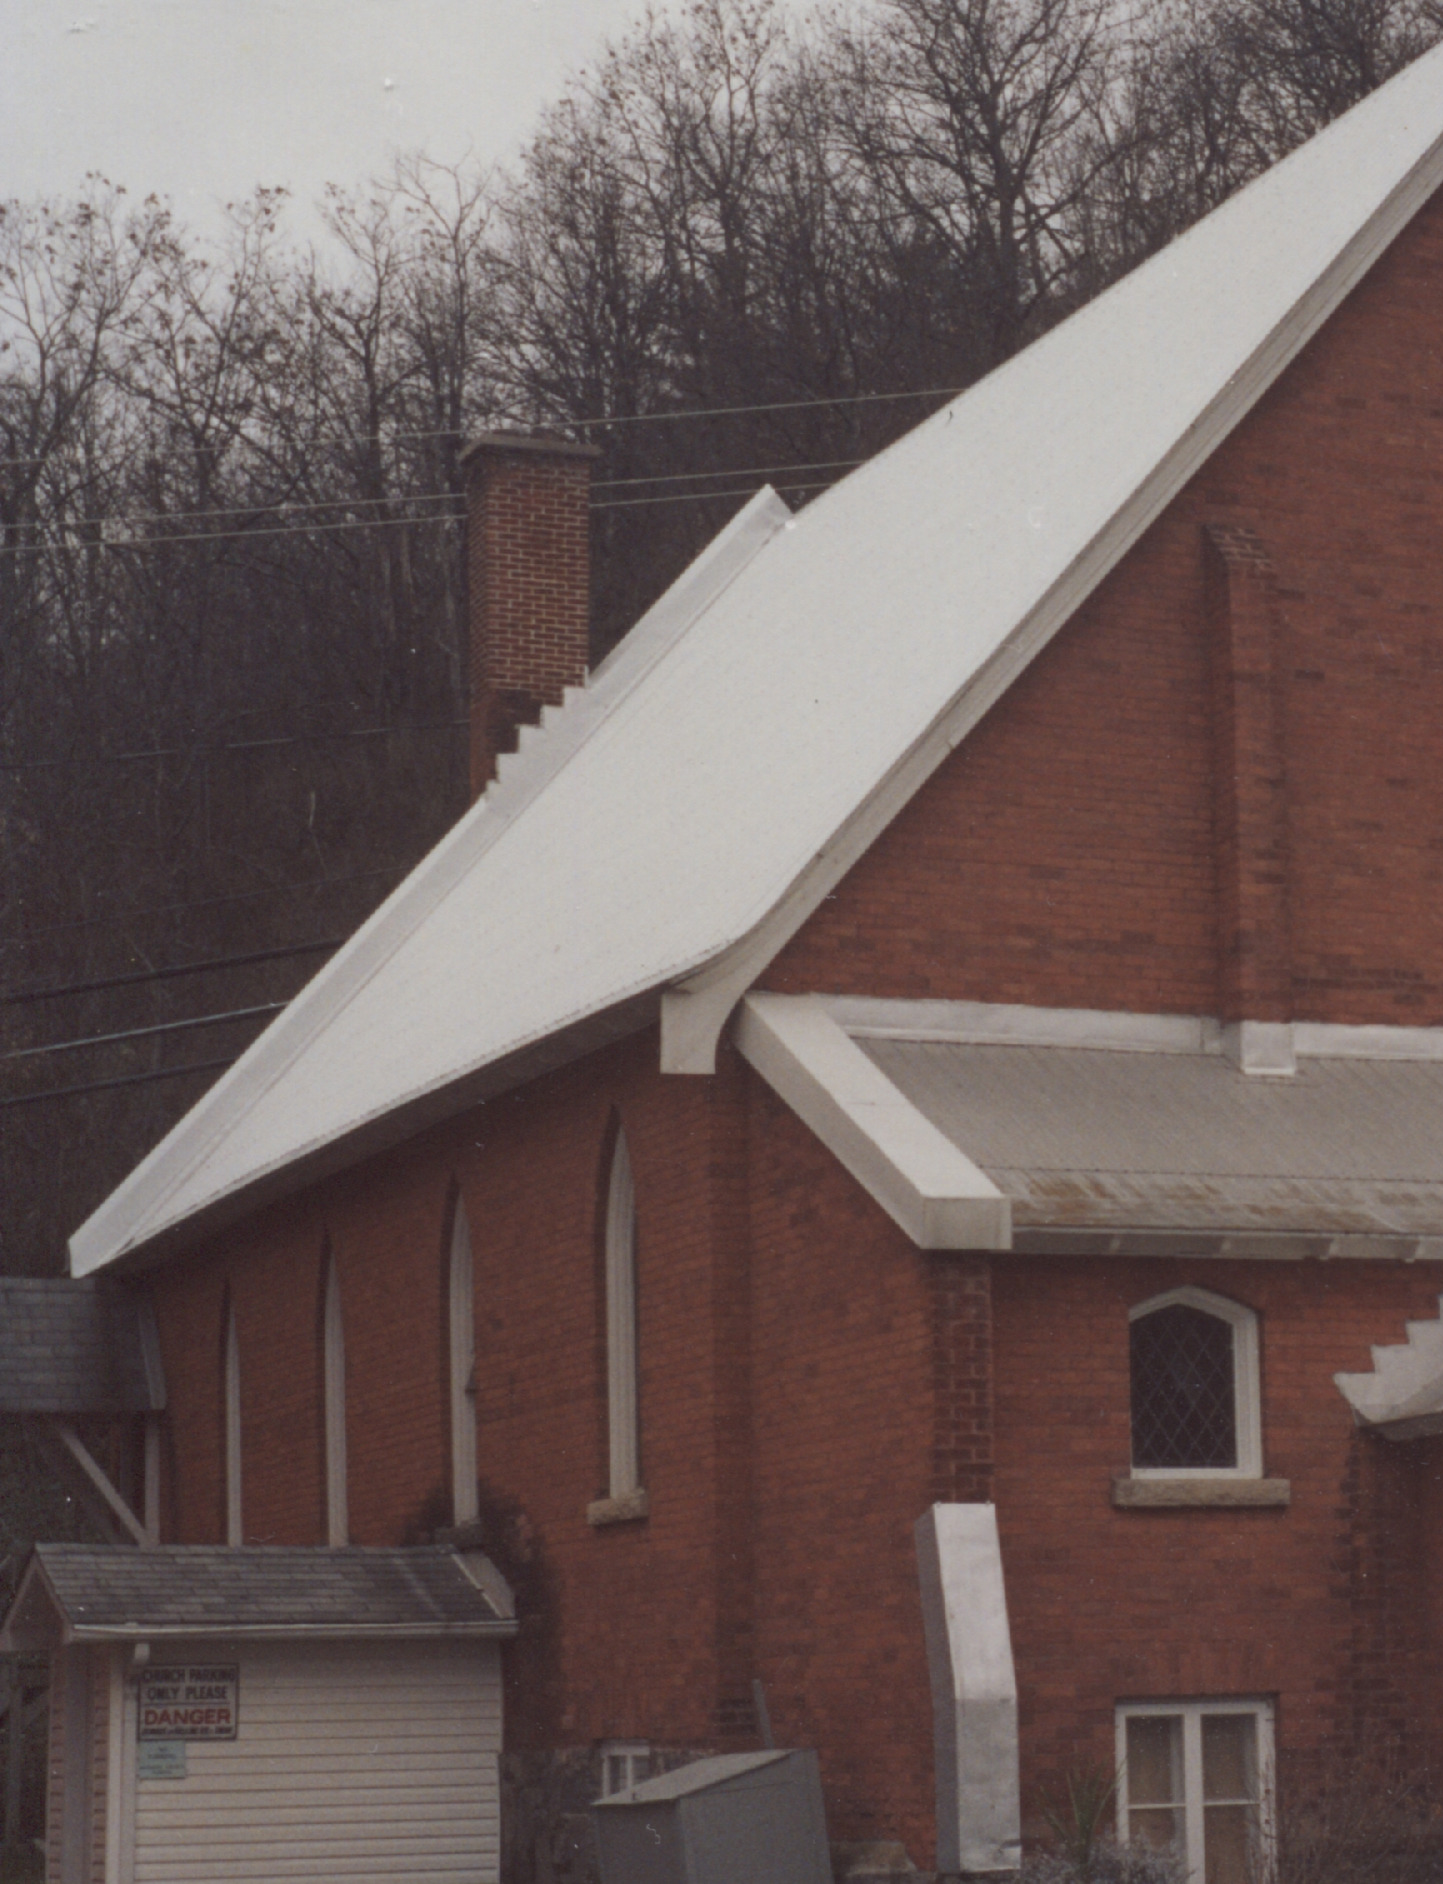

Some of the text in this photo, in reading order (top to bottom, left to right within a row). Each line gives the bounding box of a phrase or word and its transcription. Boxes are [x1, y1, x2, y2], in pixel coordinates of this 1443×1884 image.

[143, 1668, 236, 1682] CHURCH PARKING
[147, 1685, 228, 1700] ONLY PLEASE
[144, 1708, 231, 1726] DANGER
